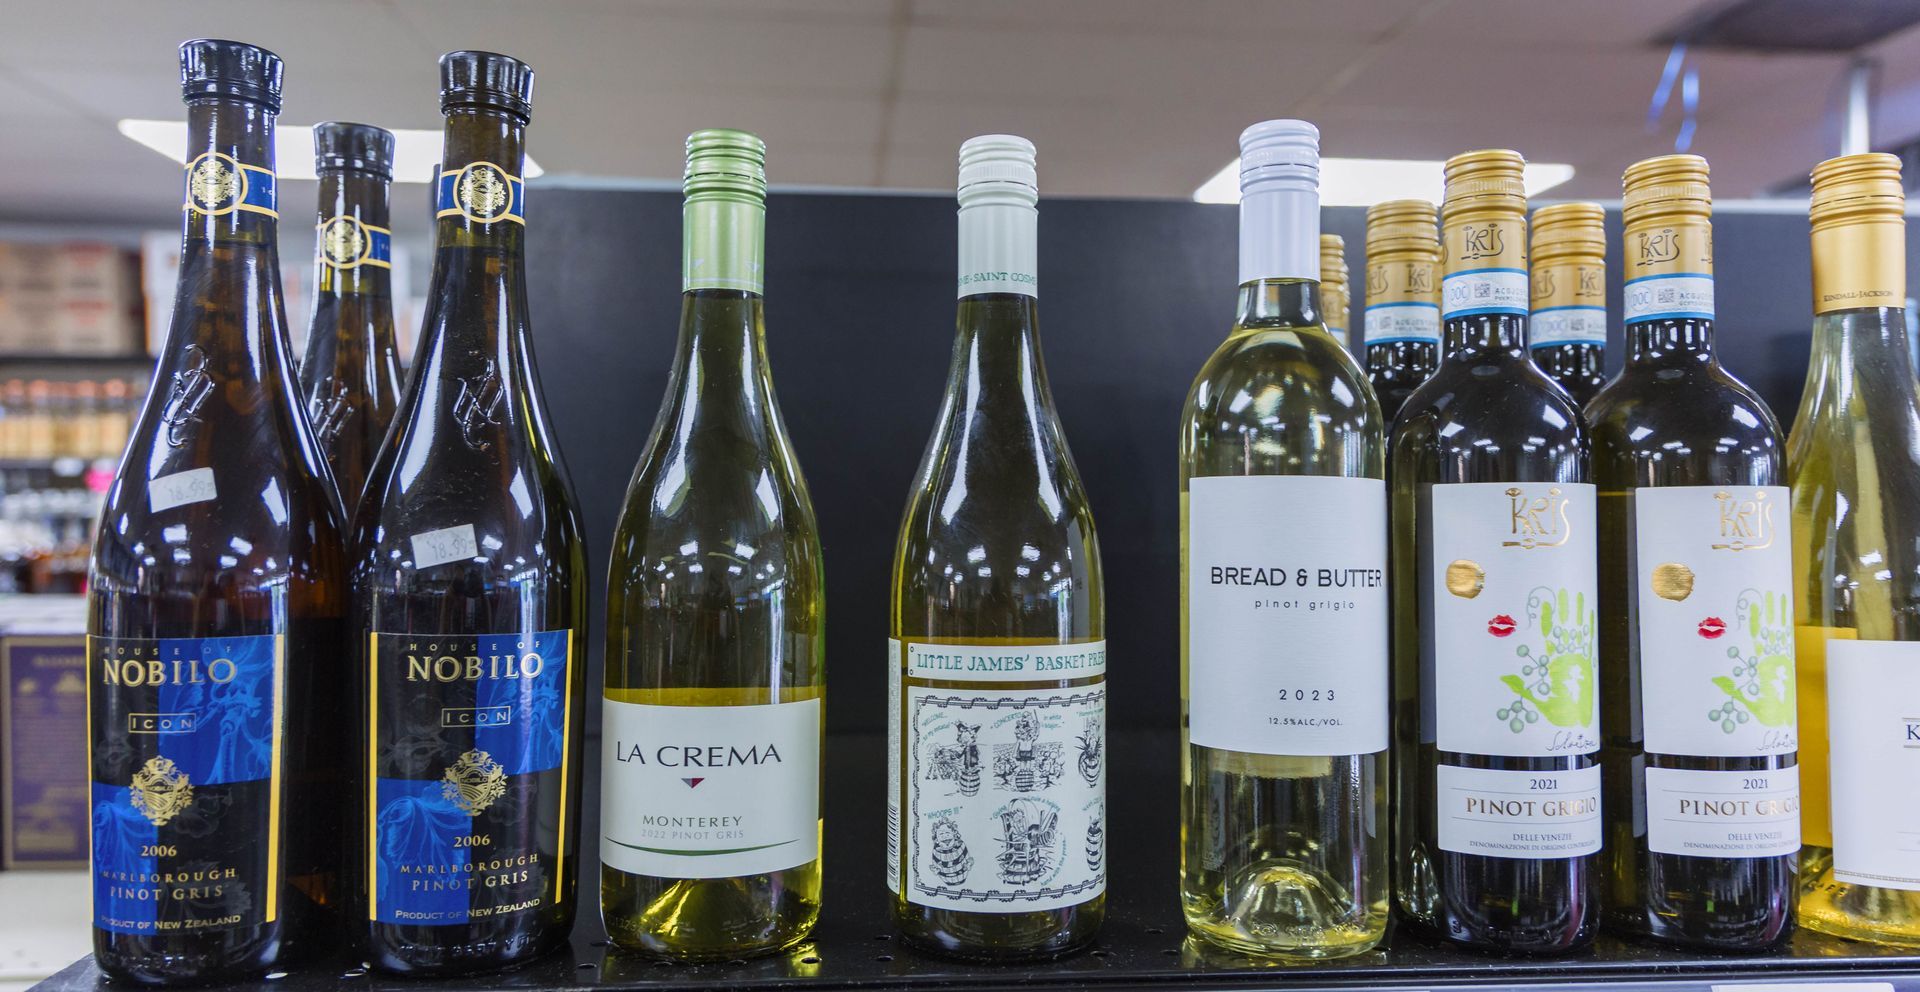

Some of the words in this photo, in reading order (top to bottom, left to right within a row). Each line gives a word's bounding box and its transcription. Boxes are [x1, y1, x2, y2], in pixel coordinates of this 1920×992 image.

[1211, 566, 1286, 586] BREAD
[1296, 568, 1308, 587] &
[1318, 568, 1382, 588] BUTTER
[1255, 599, 1299, 609] pinot
[1309, 600, 1355, 611] grigio
[105, 647, 181, 656] HOUSE
[410, 643, 497, 651] HOUSE
[517, 641, 541, 649] OF
[406, 653, 544, 682] NOBILO
[917, 653, 963, 670] LITTLE
[1035, 654, 1086, 671] BASKET
[103, 658, 239, 687] NOBILO
[1279, 689, 1335, 701] 2023
[132, 716, 194, 730] ICON
[446, 711, 506, 723] ICON
[616, 741, 646, 765] LA
[656, 743, 782, 767] CREMA
[1530, 779, 1557, 790] 2021
[1743, 778, 1769, 789] 2021
[1466, 797, 1536, 816] PINOT
[1543, 796, 1597, 816] GRIGIO
[1680, 799, 1750, 816] PINOT
[642, 815, 743, 828] MONTEREY
[453, 834, 491, 848] 2006
[641, 829, 666, 840] 2022
[671, 831, 709, 840] PINOT
[716, 830, 744, 839] GRIS
[1513, 833, 1540, 842] DELLE
[1728, 832, 1752, 841] DELLE
[140, 845, 178, 857] 2006
[400, 853, 538, 874] MARLBOROUGH
[103, 868, 237, 883] MARLBOROUGH
[412, 878, 475, 891] PINOT
[485, 870, 528, 888] GRIS
[111, 886, 163, 901] PINOT
[172, 885, 224, 901] GRIS
[395, 909, 444, 920] PRODUCT
[448, 911, 462, 920] OF
[467, 907, 493, 918] NEW
[495, 898, 541, 914] ZEALAND
[137, 921, 152, 930] OF
[154, 919, 182, 930] NEW
[184, 914, 241, 929] ZEALAND
